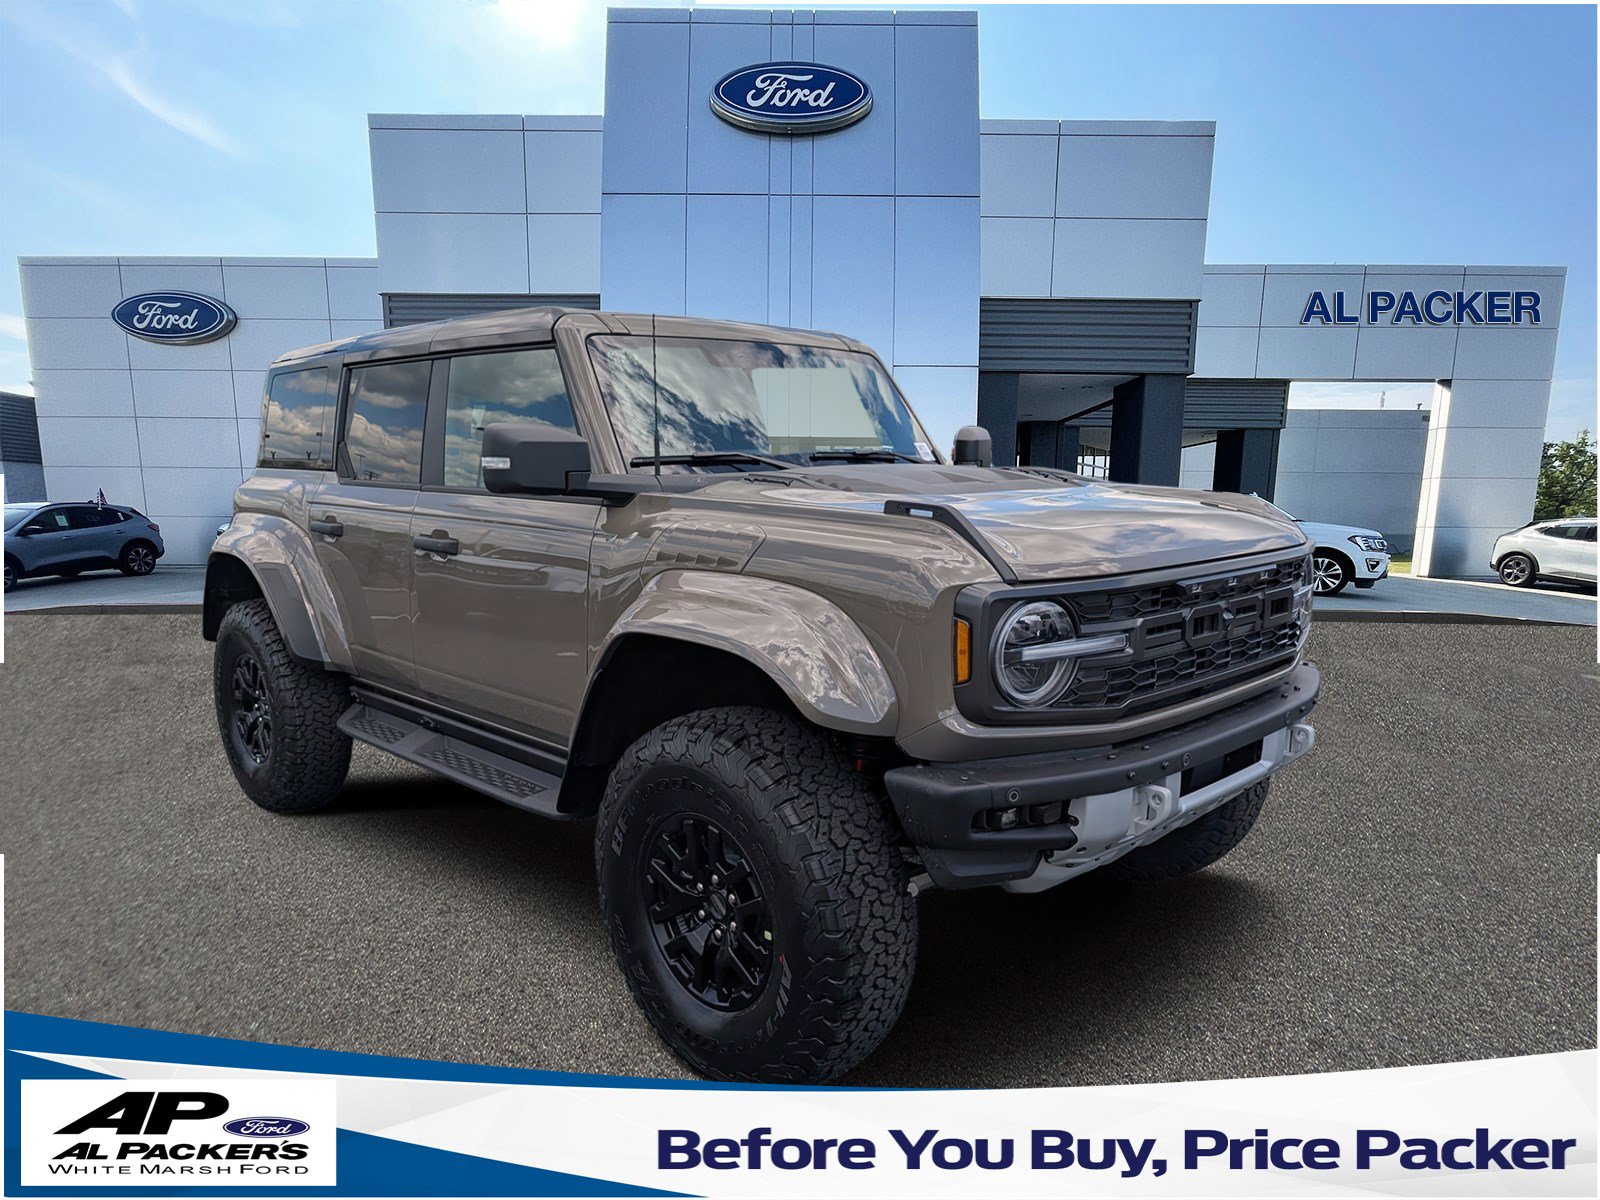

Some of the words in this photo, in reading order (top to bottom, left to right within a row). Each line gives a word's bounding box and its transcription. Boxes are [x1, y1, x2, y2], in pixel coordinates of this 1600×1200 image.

[746, 73, 836, 107] Ford
[133, 301, 199, 329] Ford
[1301, 290, 1360, 324] AL
[1368, 290, 1542, 324] PACKER
[1136, 587, 1294, 660] FORD
